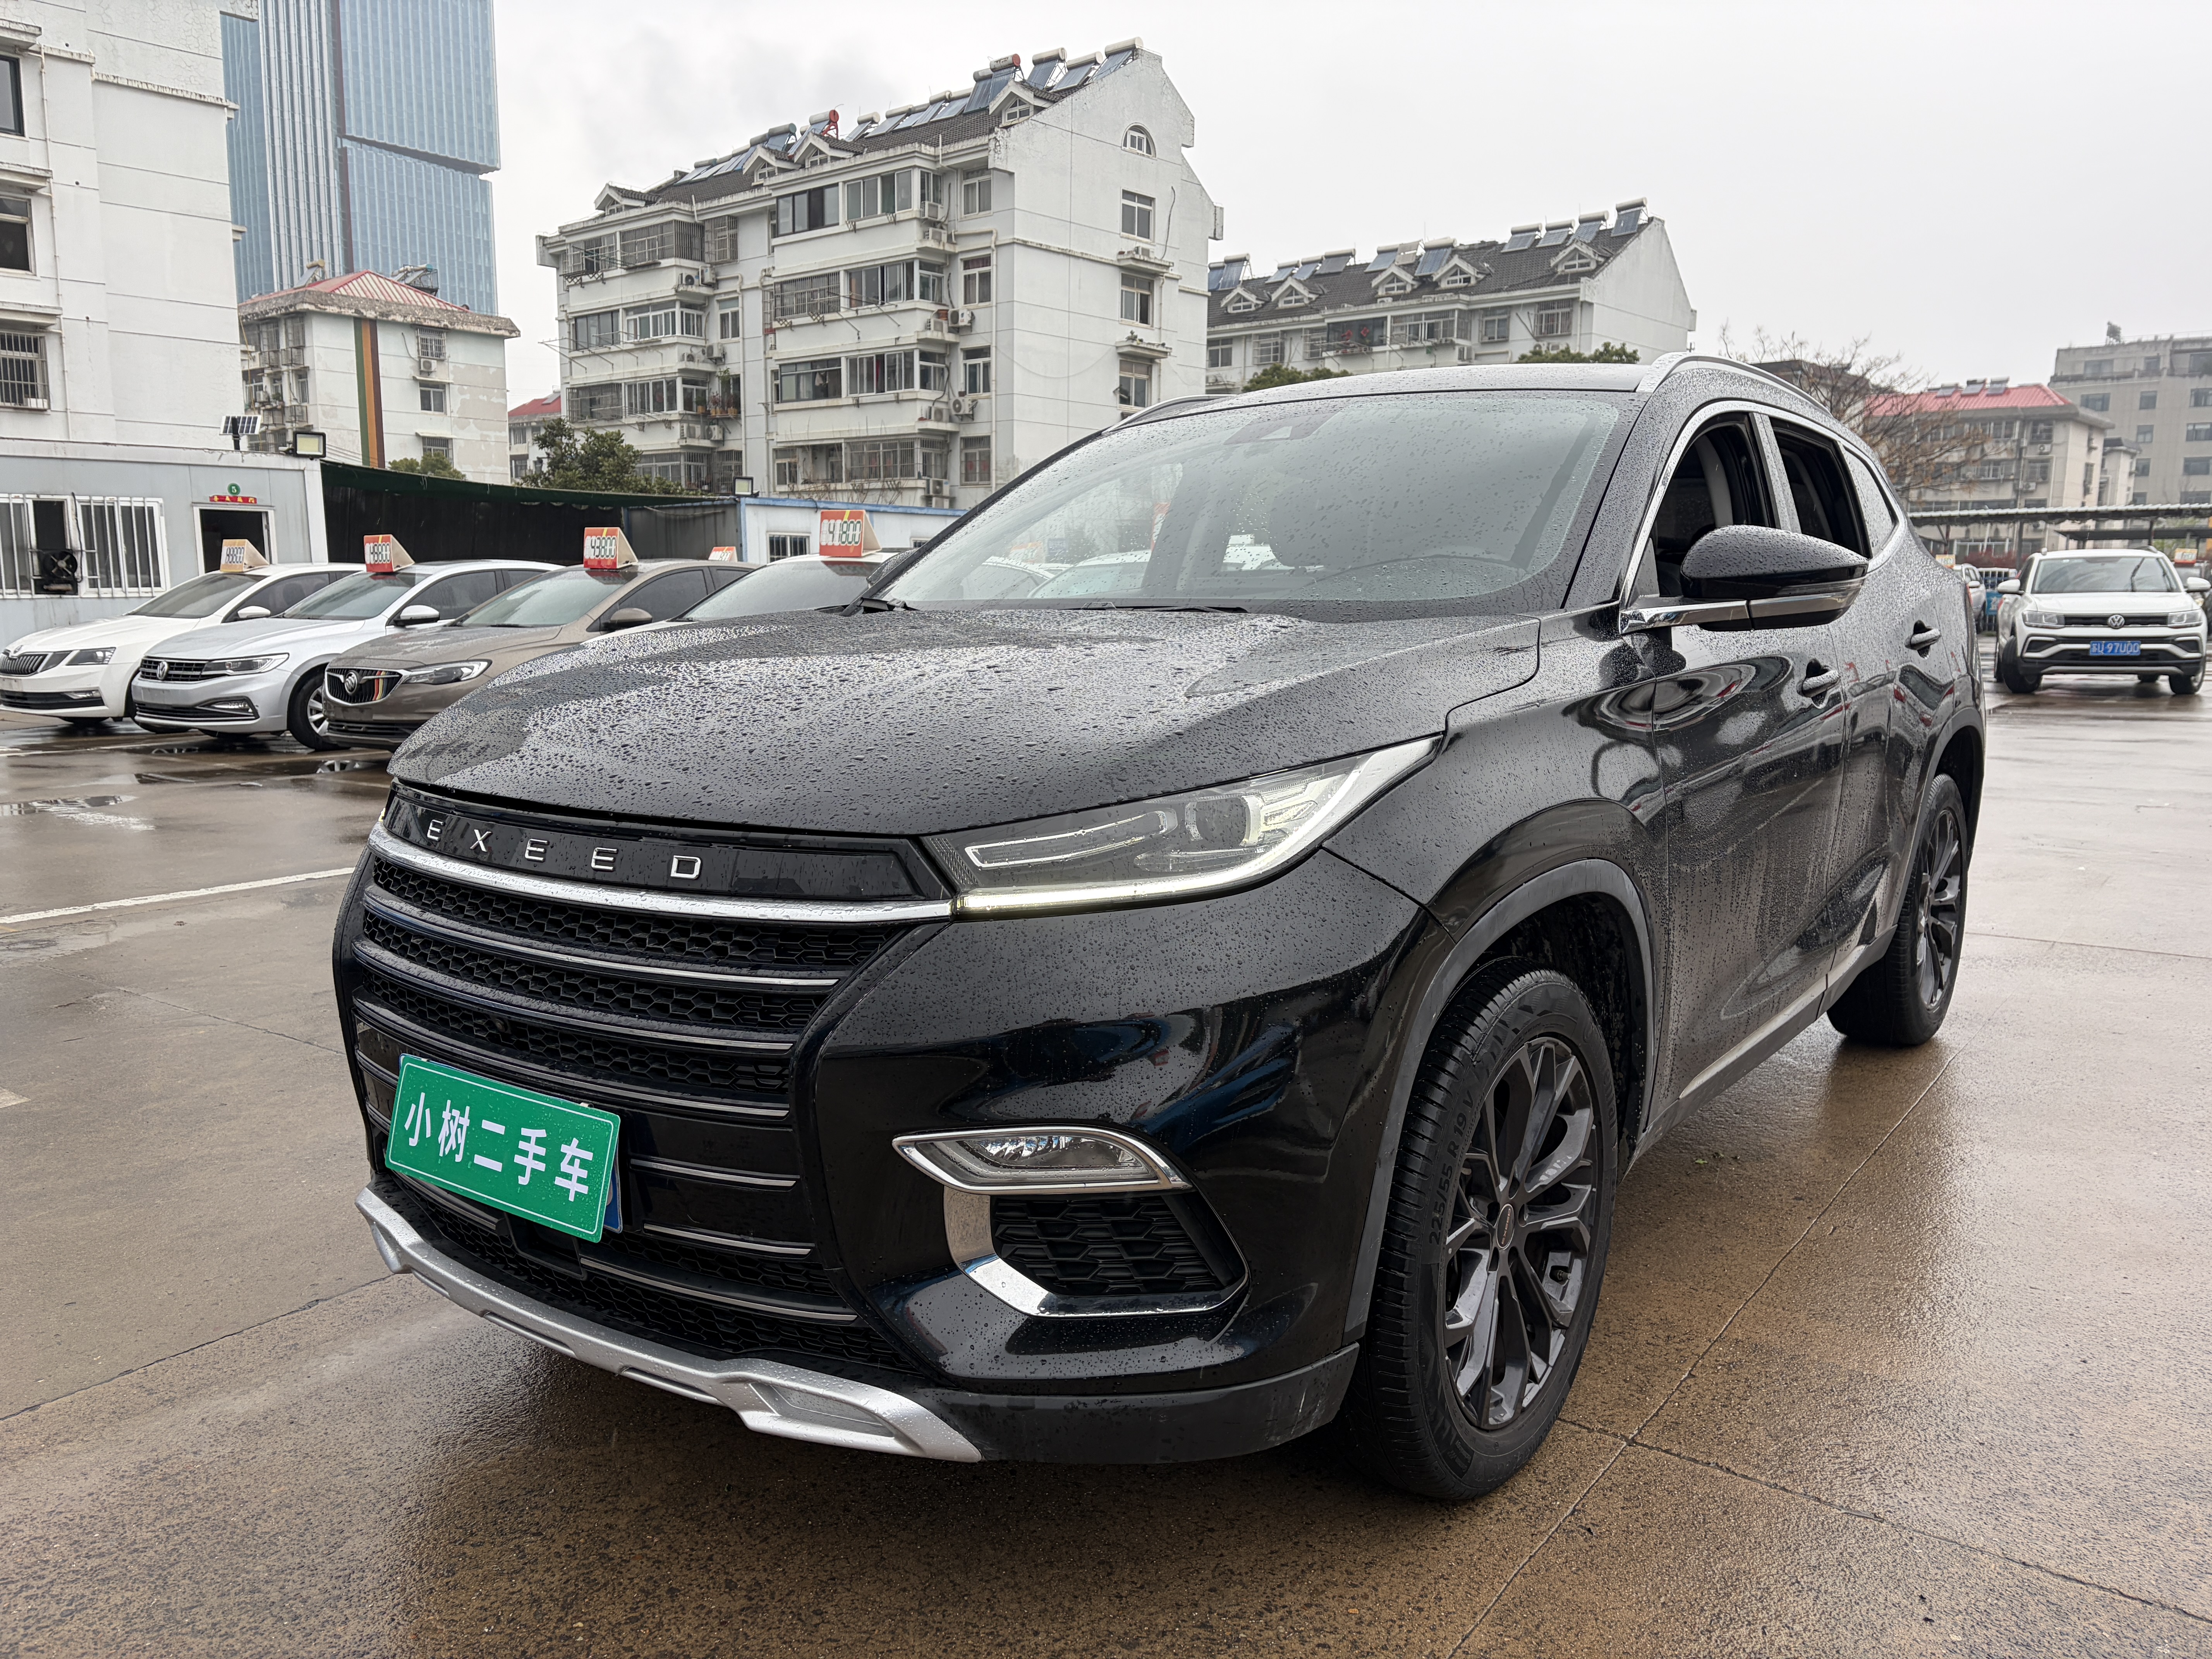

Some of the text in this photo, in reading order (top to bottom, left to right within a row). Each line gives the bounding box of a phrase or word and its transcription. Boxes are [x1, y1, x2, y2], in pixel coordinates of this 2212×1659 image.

[591, 537, 617, 558] 43800
[426, 819, 702, 880] EXEED
[404, 1092, 593, 1202] 小树二手车
[1429, 1089, 1474, 1245] 225/55 R 19 V
[1501, 1208, 1511, 1245] EXEED
